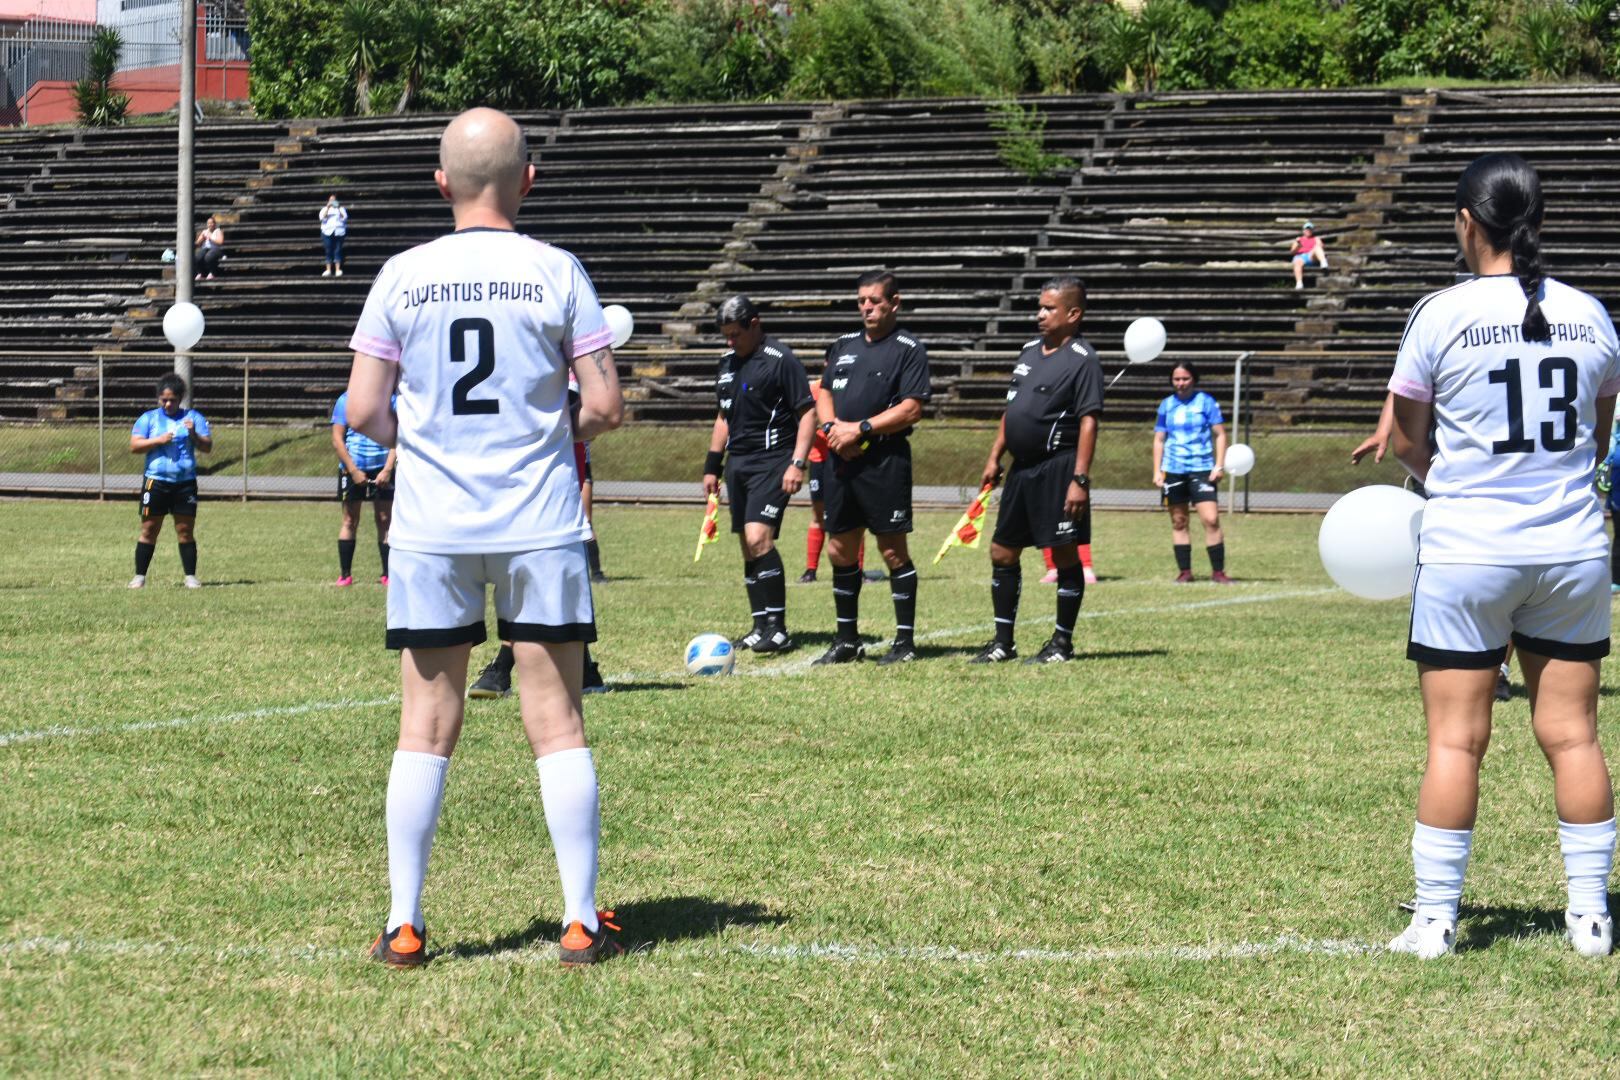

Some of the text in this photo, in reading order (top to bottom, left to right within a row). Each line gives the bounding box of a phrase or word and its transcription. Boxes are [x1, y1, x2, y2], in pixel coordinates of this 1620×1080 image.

[403, 281, 544, 310] JUVENTUS PAVAS
[449, 317, 500, 416] 2
[1462, 324, 1522, 349] JUVENT
[1488, 356, 1578, 455] 13
